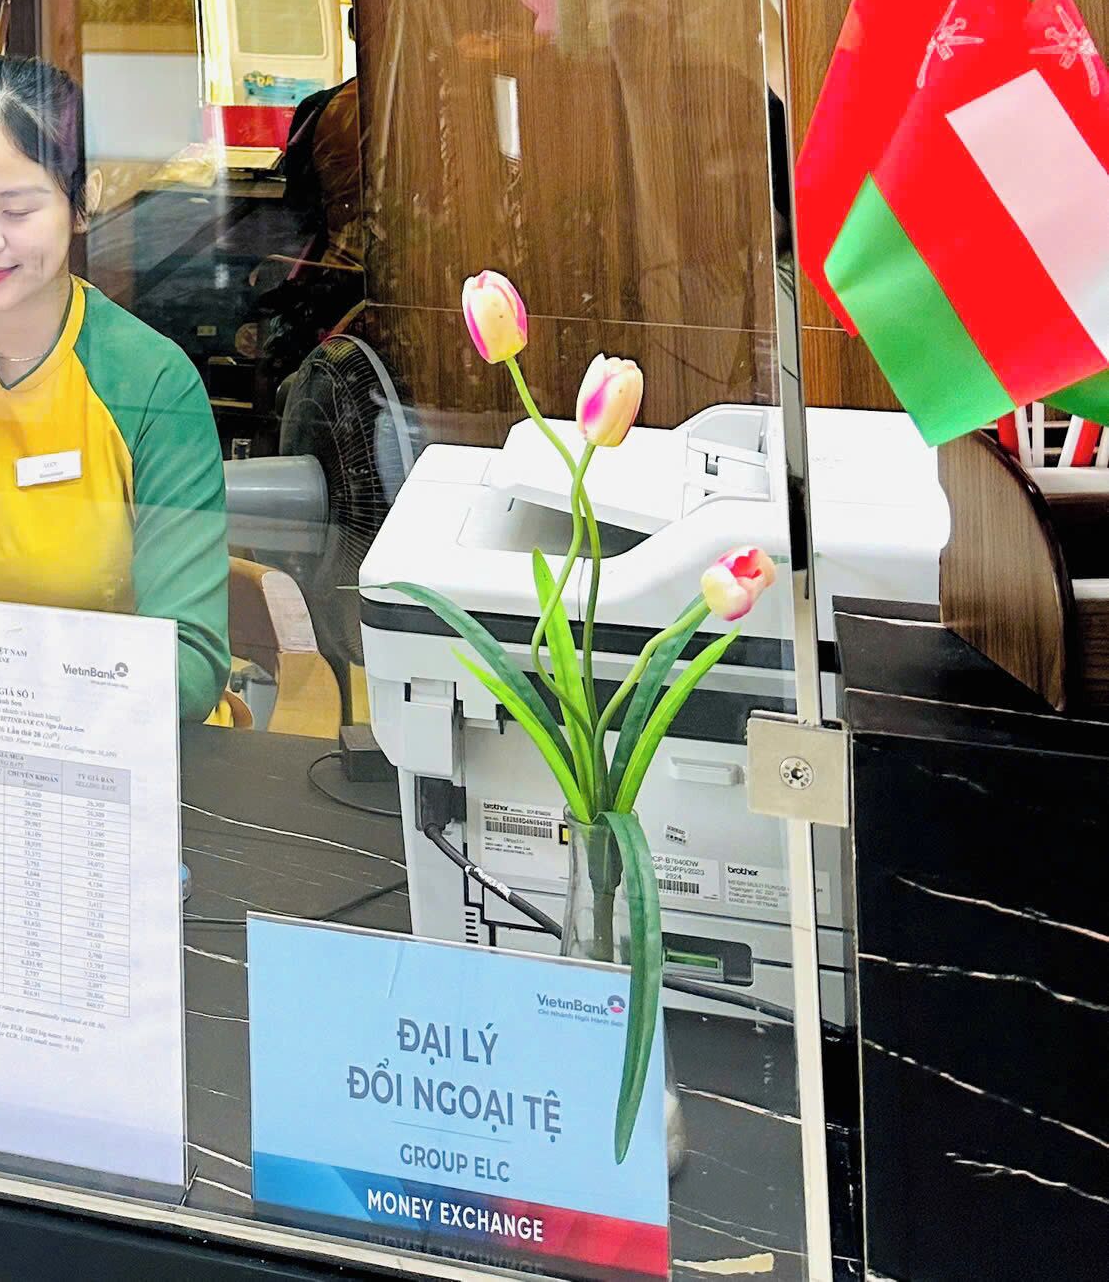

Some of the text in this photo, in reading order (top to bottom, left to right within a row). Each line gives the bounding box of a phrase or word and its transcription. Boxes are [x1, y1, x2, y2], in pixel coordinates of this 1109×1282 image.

[9, 648, 28, 657] NAM
[62, 662, 116, 680] VietinBank
[31, 691, 35, 699] 1
[727, 865, 759, 876] brother
[536, 993, 609, 1016] VietinBank
[396, 1017, 499, 1067] ĐẠI LÝ
[346, 1057, 562, 1143] ĐỔI NGOẠI TỆ
[399, 1143, 511, 1184] GROUP ELC
[367, 1187, 544, 1244] MONEY EXCHANGE
